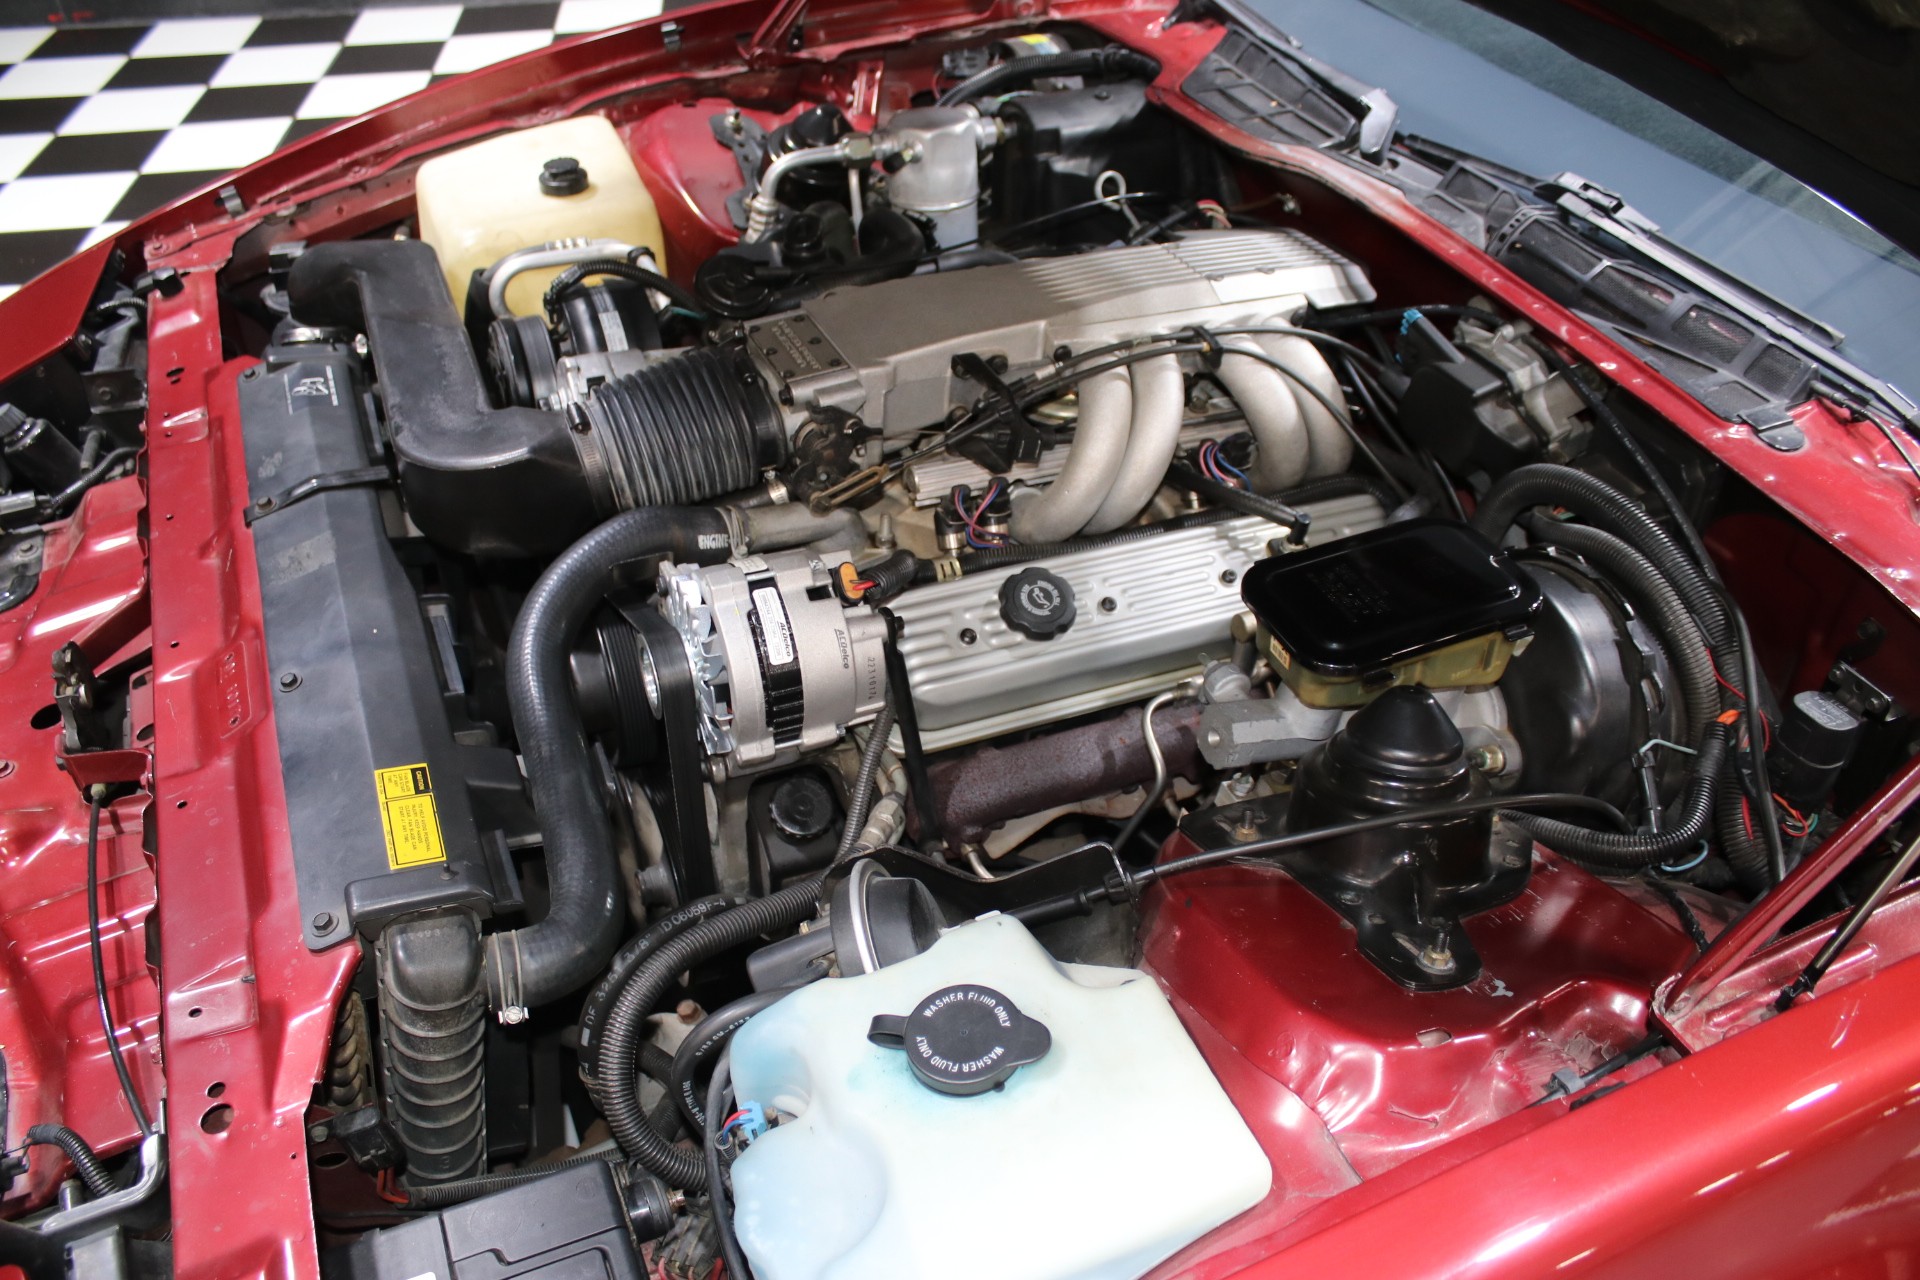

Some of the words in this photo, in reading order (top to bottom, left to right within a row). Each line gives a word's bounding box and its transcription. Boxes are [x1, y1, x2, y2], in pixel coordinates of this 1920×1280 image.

[923, 992, 964, 1018] WASHER
[994, 1006, 1011, 1028] ONLY
[915, 1036, 932, 1058] ONLY
[930, 1055, 959, 1072] FLUID
[962, 1046, 1005, 1073] WASHER
